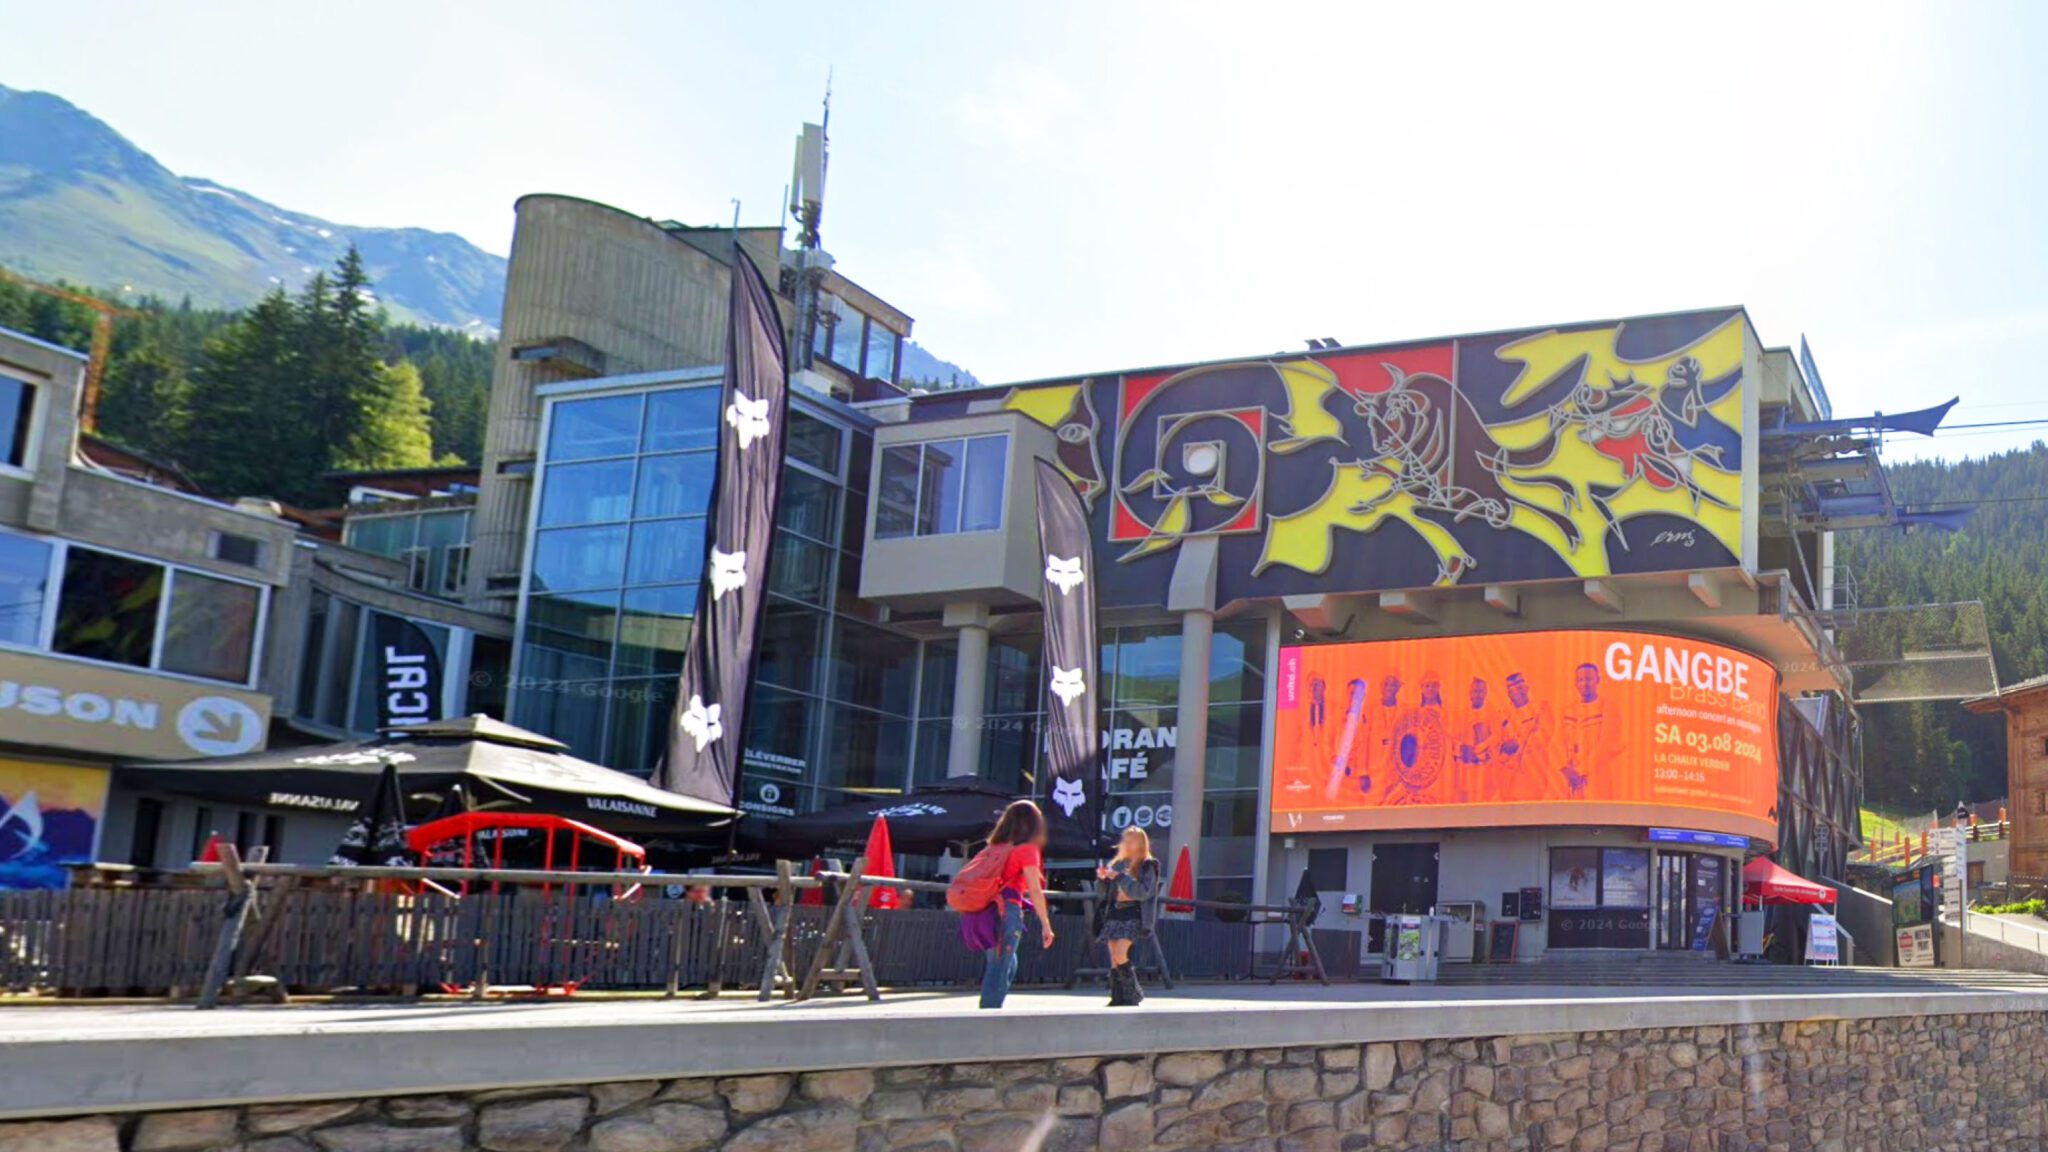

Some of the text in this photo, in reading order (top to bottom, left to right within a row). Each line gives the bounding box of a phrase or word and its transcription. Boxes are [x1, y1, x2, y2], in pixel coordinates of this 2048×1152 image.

[1604, 641, 1749, 700] GANGBE
[1670, 677, 1727, 708] Brass
[1654, 752, 1667, 763] LA
[1655, 722, 1762, 765] SA 03.08 2024
[586, 797, 658, 817] VALAISANNE
